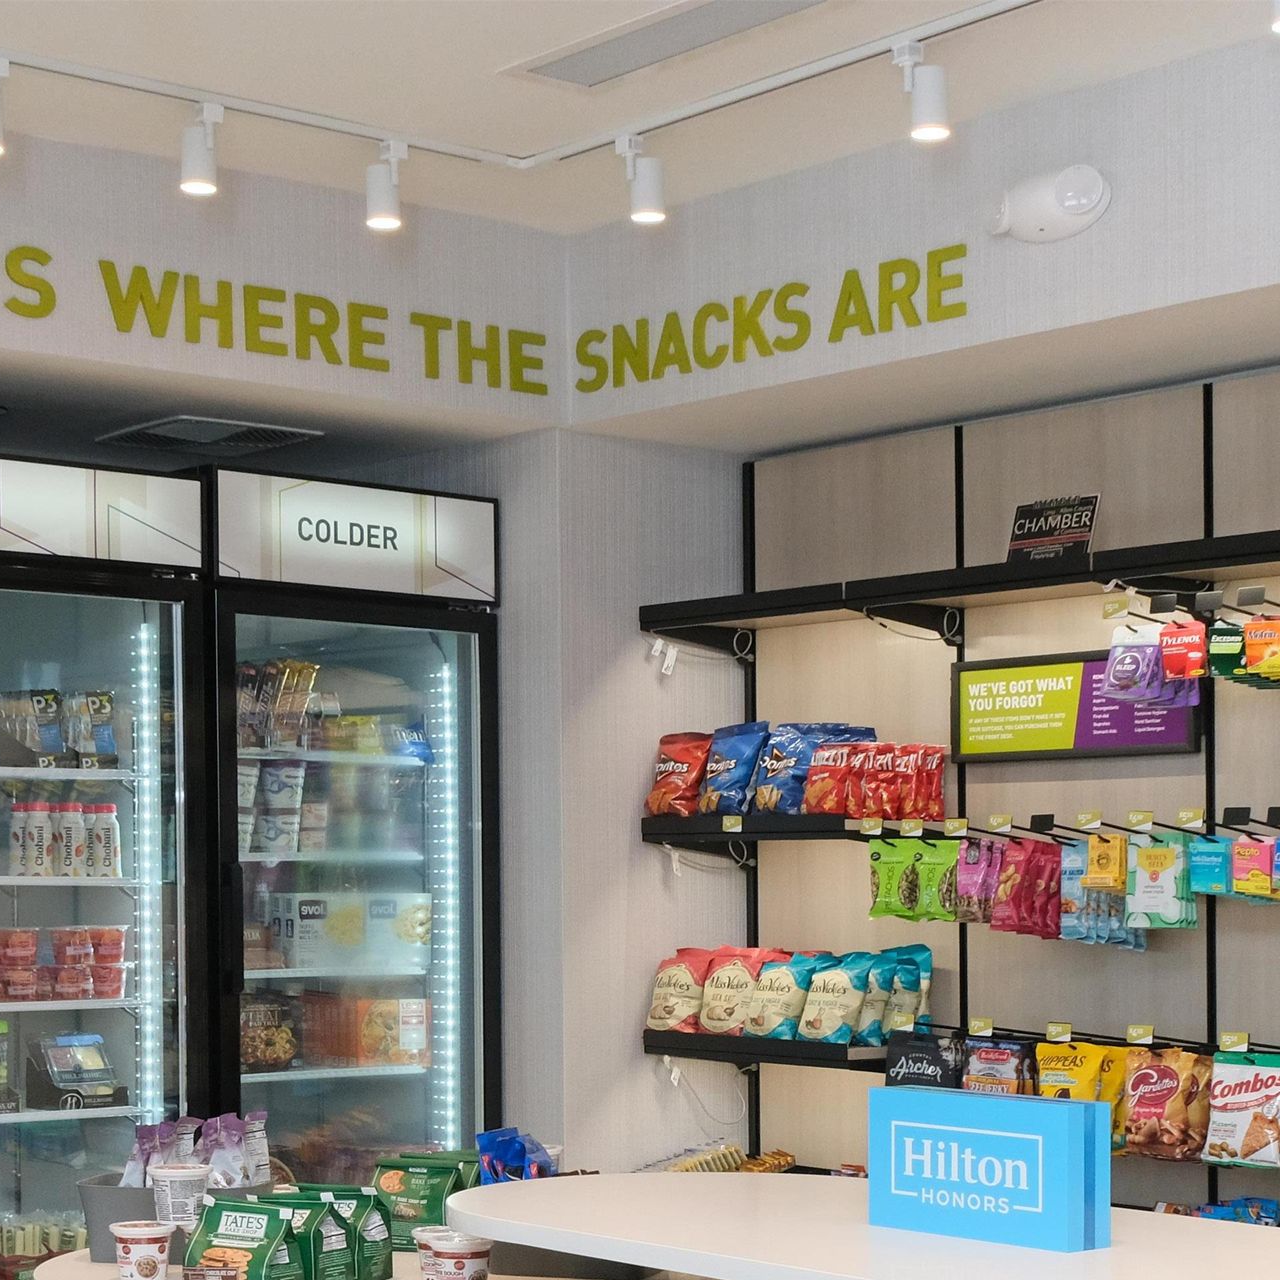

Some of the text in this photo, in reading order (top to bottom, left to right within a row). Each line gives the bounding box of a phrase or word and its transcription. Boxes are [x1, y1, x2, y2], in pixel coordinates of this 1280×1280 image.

[98, 258, 391, 373] WHERE
[410, 311, 549, 396] THE
[575, 281, 812, 394] SNACKS
[828, 243, 968, 343] ARE
[297, 516, 399, 551] COLDER
[1014, 511, 1091, 535] CHAMBER
[1161, 634, 1201, 647] TYLENOL
[1114, 663, 1137, 672] SLEEP
[968, 676, 1074, 697] WE'VE GOT WHAT
[32, 695, 57, 714] P3
[87, 695, 112, 715] P3
[968, 694, 1044, 711] YOU FORGOT
[38, 756, 56, 768] P3
[82, 757, 99, 769] P3
[35, 825, 44, 866] Chobani
[63, 826, 73, 867] Chobani
[86, 827, 94, 867] Chobani
[103, 827, 112, 867] Chobani
[1234, 847, 1260, 857] Pepto
[889, 1054, 942, 1083] Archer
[1040, 1055, 1086, 1068] HIPPEAS
[1127, 1066, 1180, 1107] Gardetto's
[903, 1136, 1030, 1190] Hilton
[921, 1188, 1010, 1214] HONORS
[224, 1214, 265, 1230] TATE'S
